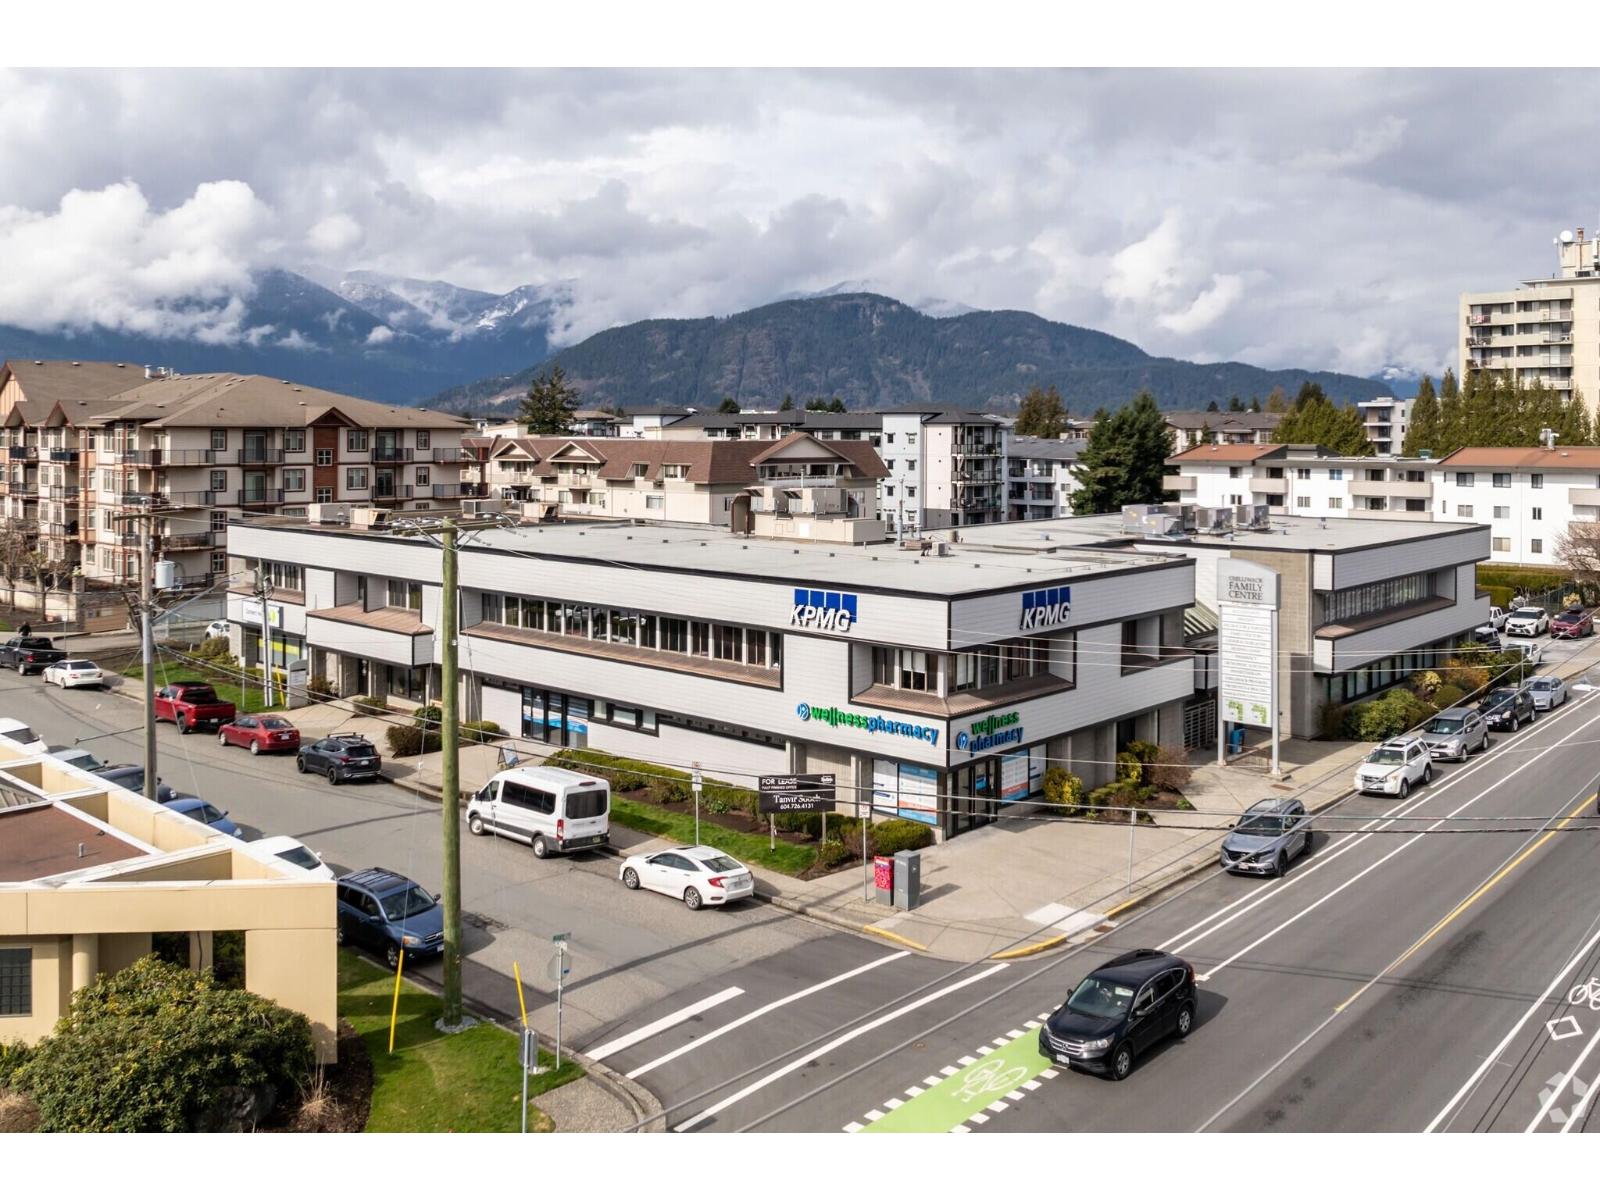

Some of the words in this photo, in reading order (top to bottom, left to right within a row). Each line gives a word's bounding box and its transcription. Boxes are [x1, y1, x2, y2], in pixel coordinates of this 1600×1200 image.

[1228, 581, 1263, 591] FAMILY
[1228, 590, 1264, 601] CENTRE
[789, 604, 851, 632] KPMG
[1022, 601, 1071, 630] KPMG
[970, 711, 1020, 736] wellness
[970, 727, 1024, 758] pharmacy
[773, 795, 797, 803] Tanvir
